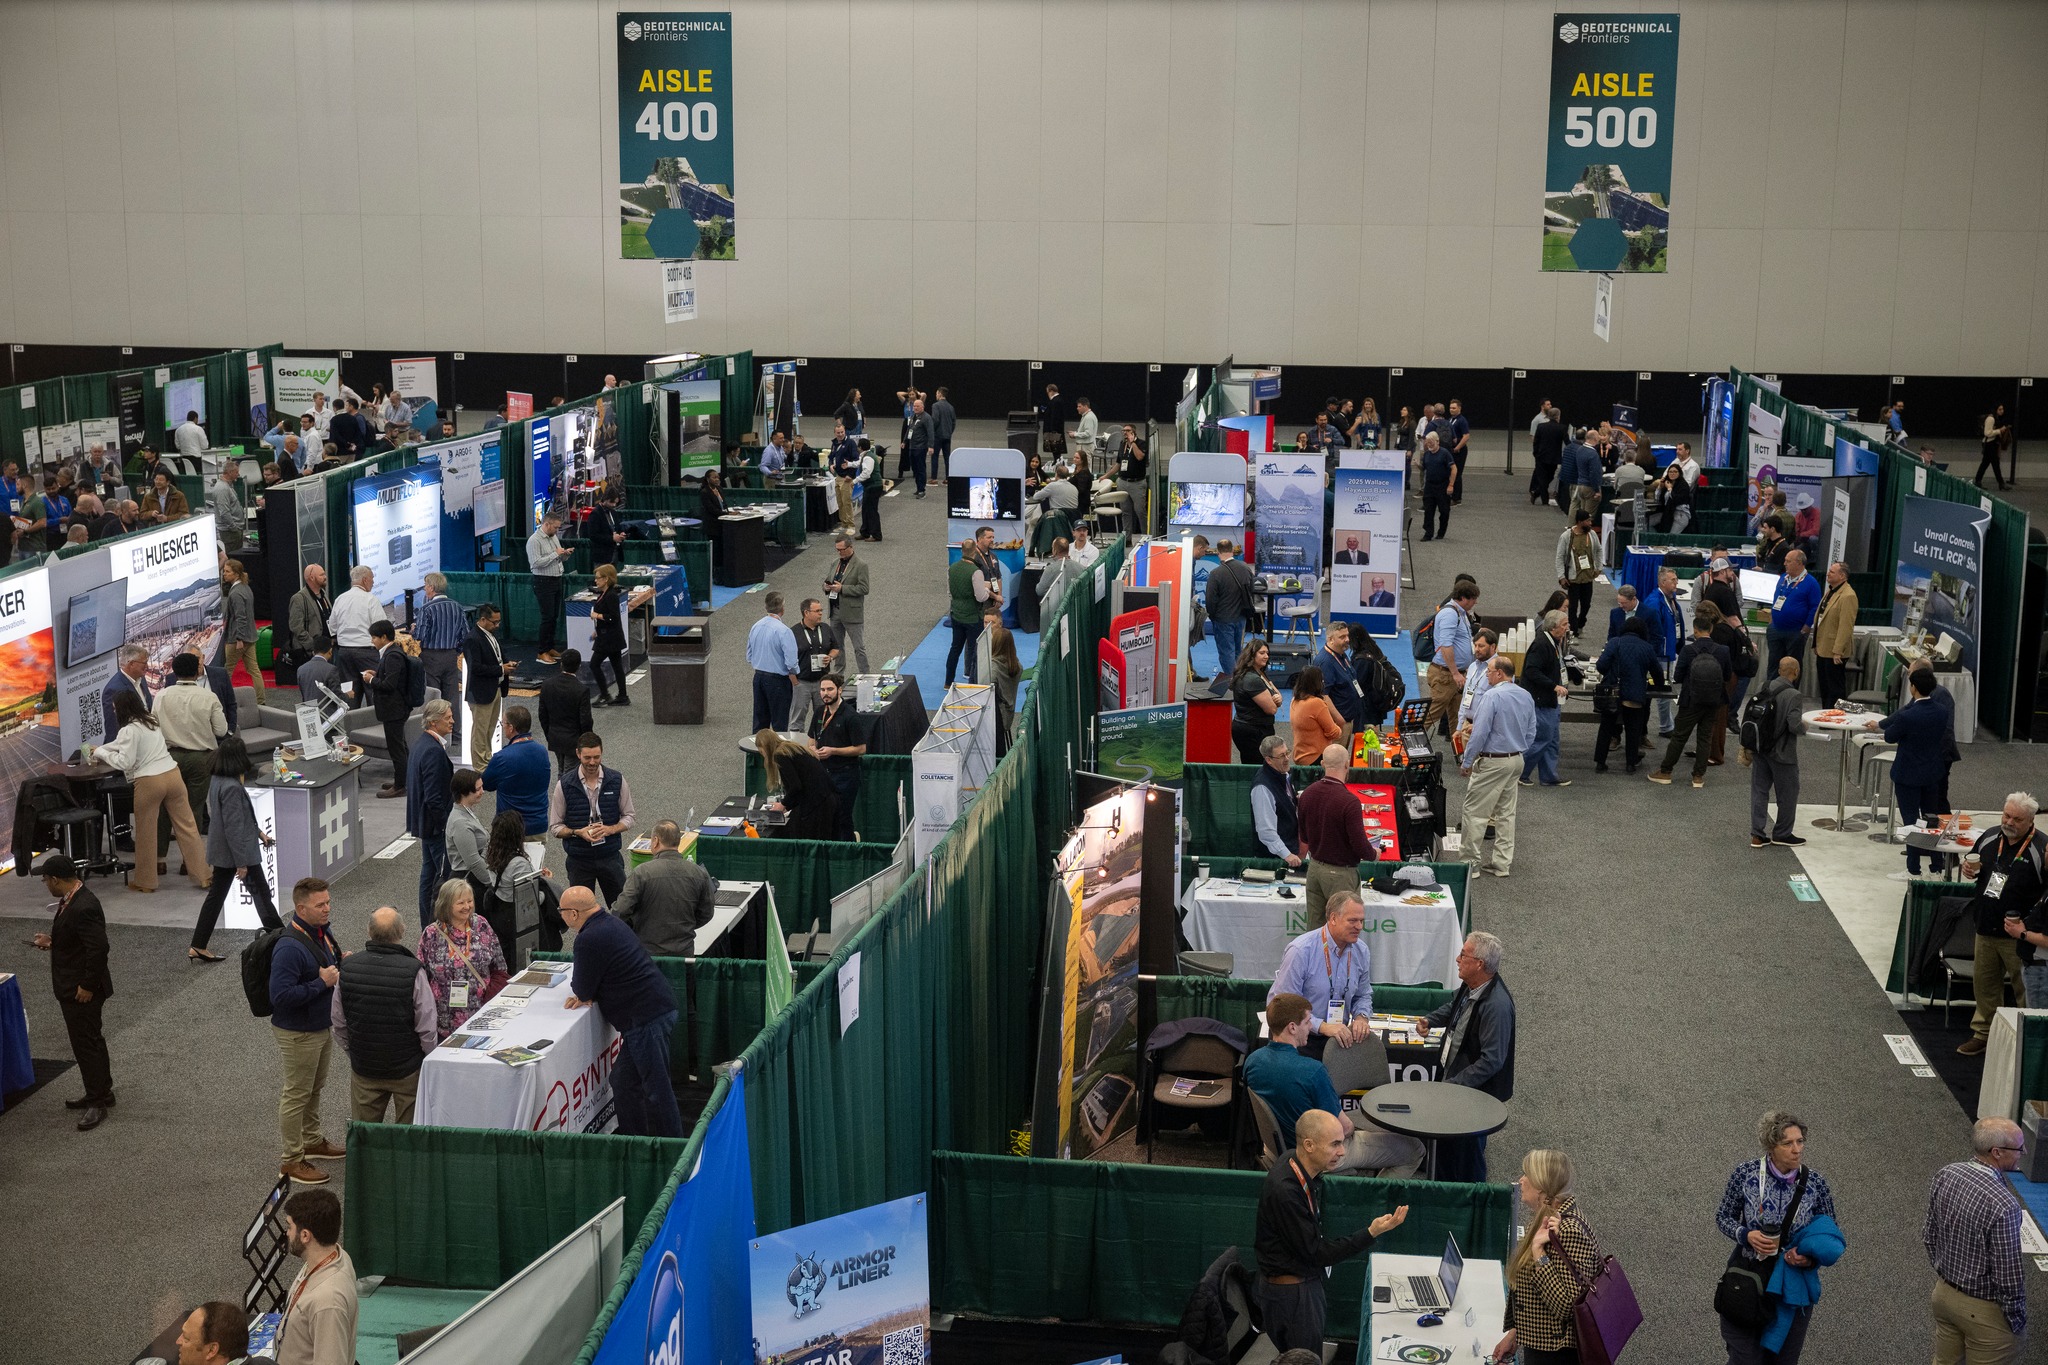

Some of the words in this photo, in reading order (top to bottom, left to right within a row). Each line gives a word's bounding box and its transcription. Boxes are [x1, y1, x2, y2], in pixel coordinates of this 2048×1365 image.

[644, 21, 726, 33] GEOTECHNICAL
[1581, 22, 1673, 34] GEOTECHNICAL
[644, 31, 688, 41] Frontiers
[1581, 33, 1630, 43] Frontiers
[638, 69, 713, 93] AISLE
[1571, 72, 1654, 97] AISLE
[635, 102, 718, 141] 400
[1564, 106, 1658, 148] 500
[667, 267, 682, 282] BOOTH
[279, 368, 327, 378] GeoCAAB
[1760, 445, 1770, 455] CTT
[1925, 528, 1949, 543] Unroll
[145, 531, 199, 568] HUESKER
[1913, 541, 1928, 557] Let
[1930, 545, 1944, 560] ITL
[1966, 556, 1977, 573] Sho
[0, 589, 26, 618] KER
[1120, 634, 1153, 651] HUMBOLDT
[67, 675, 79, 685] Learn
[79, 672, 90, 680] more
[89, 665, 101, 677] about
[66, 680, 91, 695] Geotechnical
[1101, 716, 1126, 725] Building
[1159, 710, 1183, 720] Naue
[1101, 722, 1138, 734] sustainable
[1100, 732, 1135, 743] ground.
[1362, 918, 1397, 933] ue
[573, 1036, 622, 1111] SYNTE
[585, 1101, 616, 1134] ACCAFERRI
[830, 1245, 897, 1277] ARMOR
